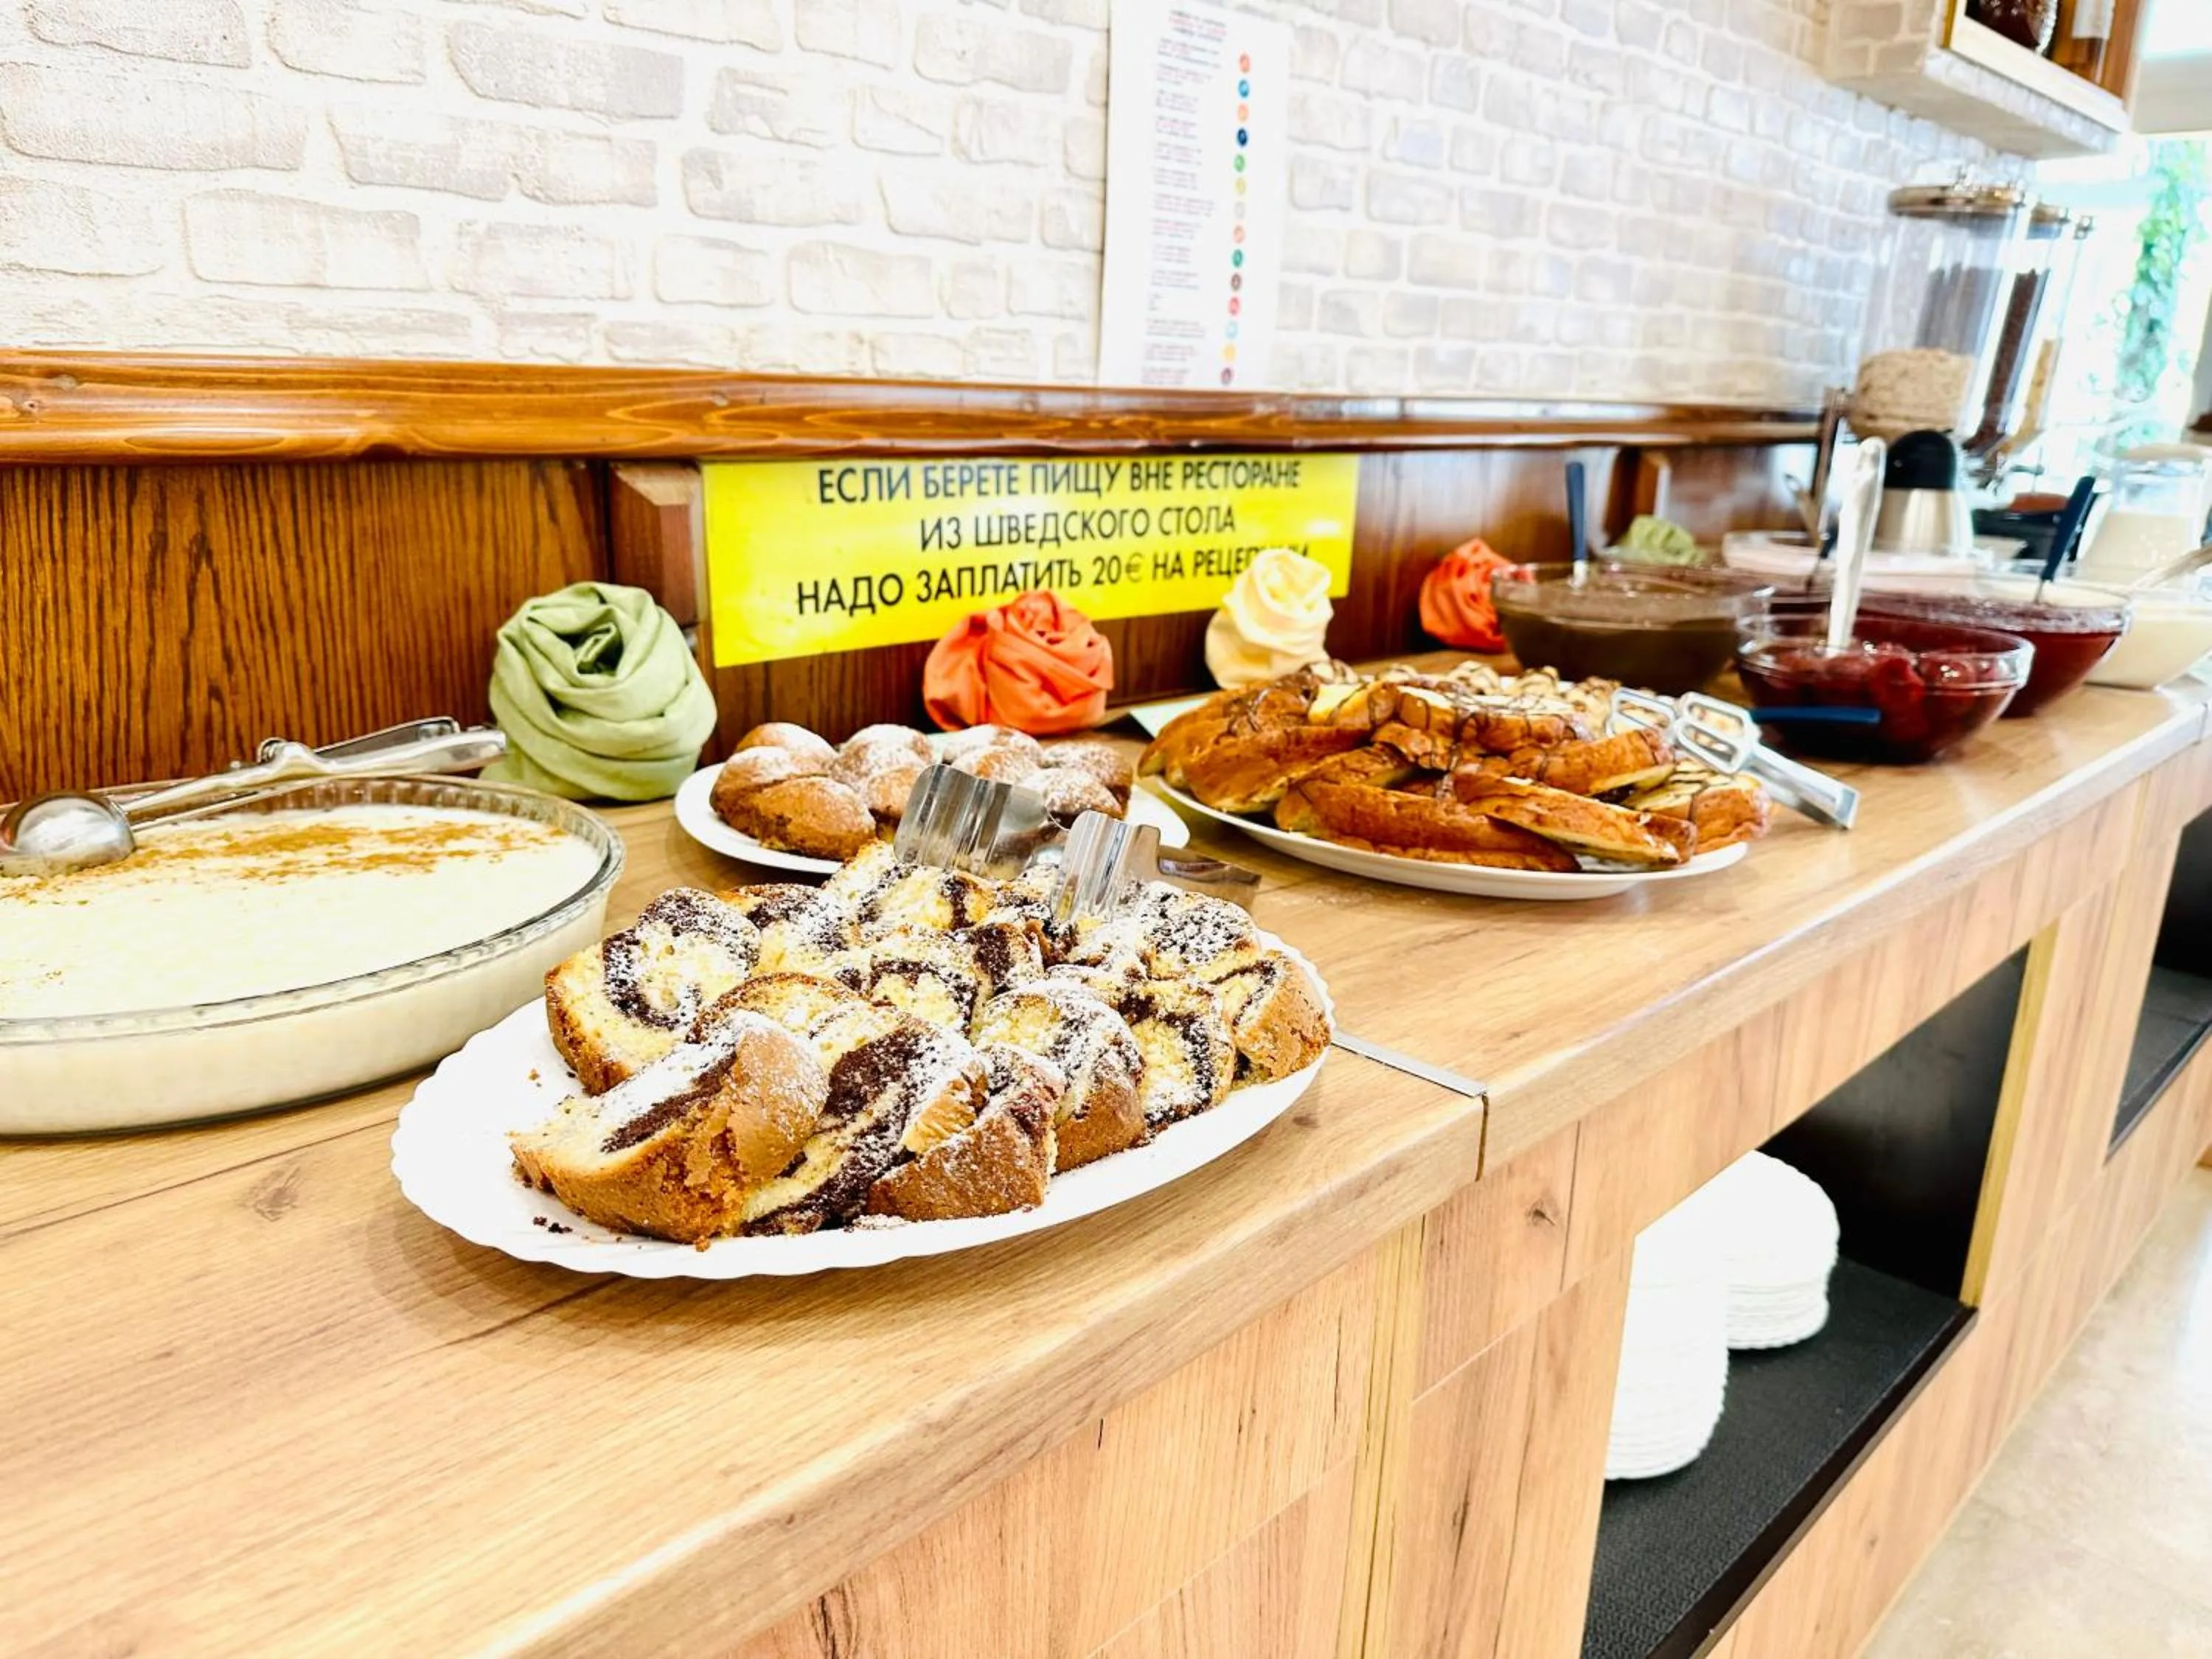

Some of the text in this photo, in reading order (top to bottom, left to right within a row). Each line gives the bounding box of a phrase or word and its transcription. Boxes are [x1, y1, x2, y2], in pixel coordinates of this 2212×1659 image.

[818, 460, 1301, 504] ЕСЛИ БЕРЕТЕ ПИЩУ ВНЕ РЕСТОРАНЕ
[921, 506, 1236, 552] ИЗ ШВЕДСКОГО СТОЛА
[797, 573, 903, 616] НАДО
[916, 559, 1082, 602] ЗАПЛАТИТЬ
[1152, 551, 1186, 581] НА
[1192, 543, 1308, 578] РЕЦЕП
